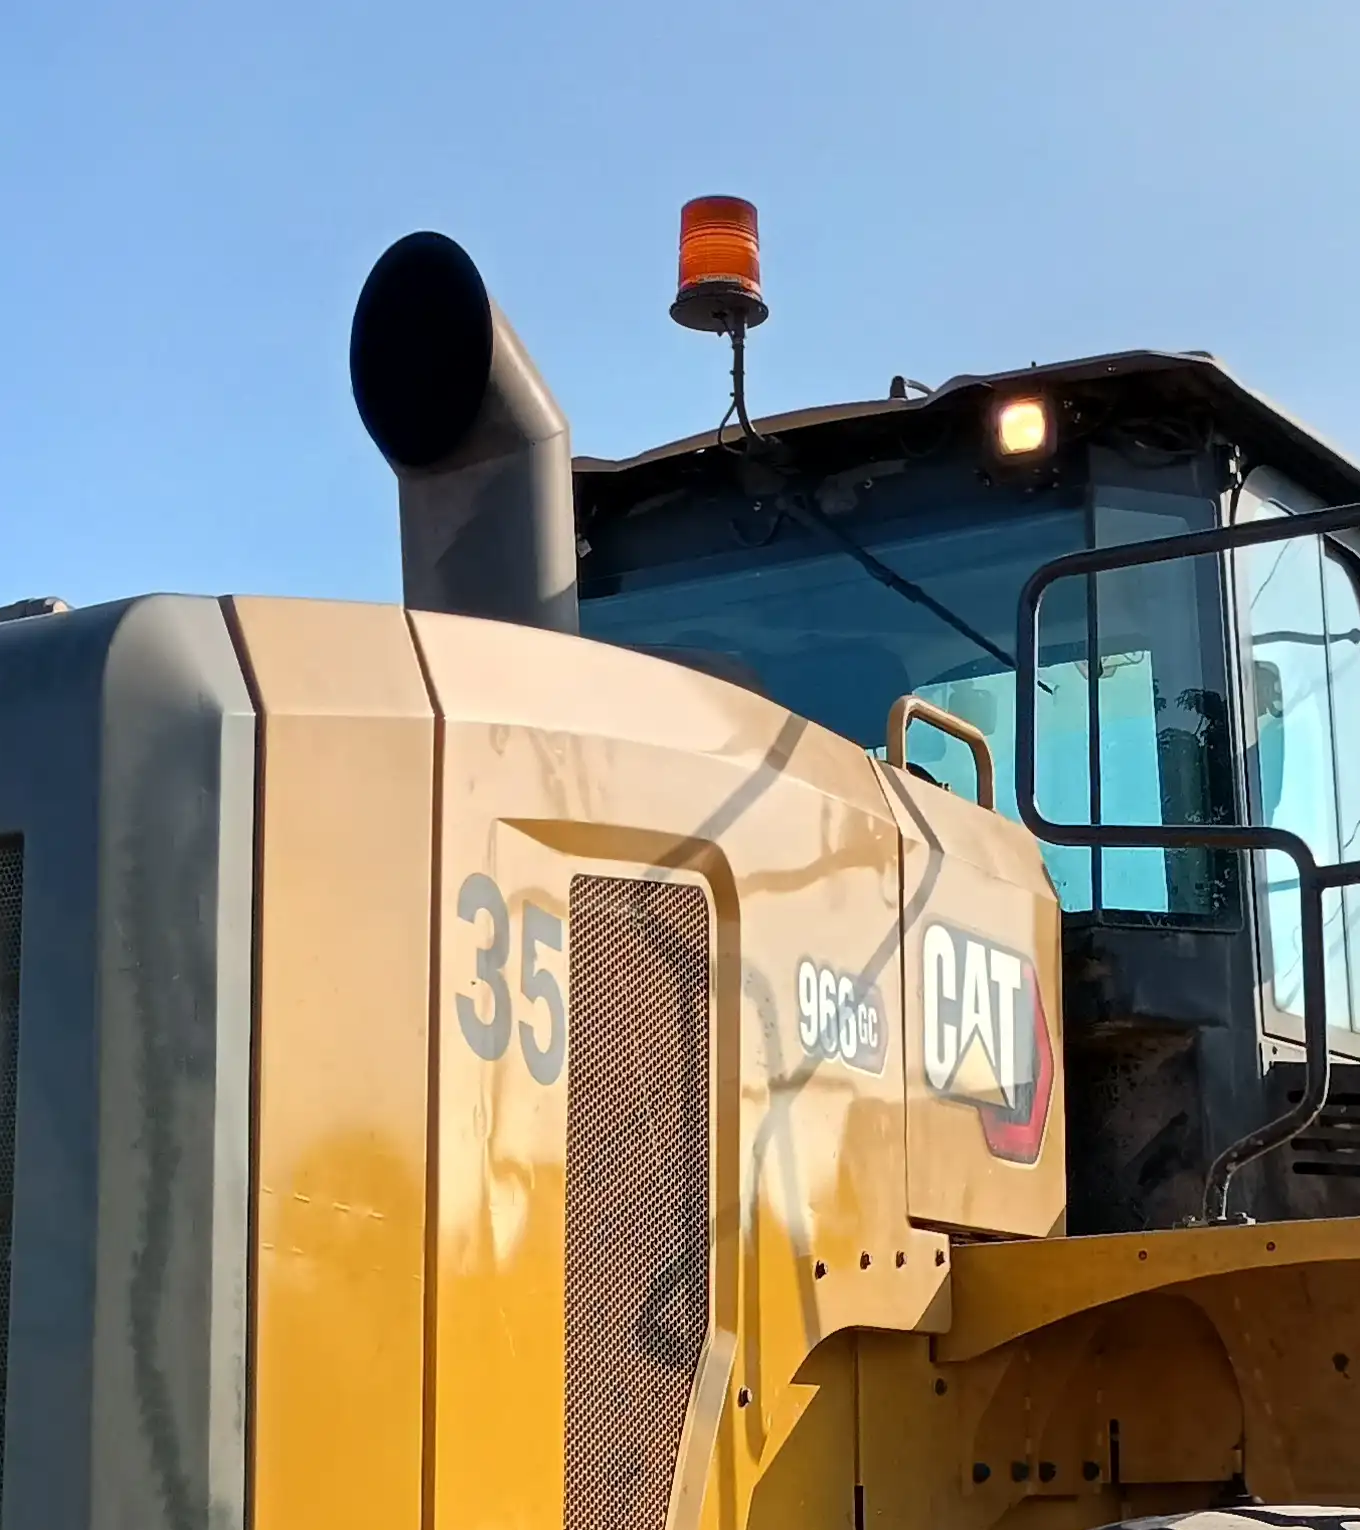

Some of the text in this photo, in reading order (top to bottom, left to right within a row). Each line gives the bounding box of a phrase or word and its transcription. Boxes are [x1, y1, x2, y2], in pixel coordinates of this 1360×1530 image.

[455, 872, 566, 1086] 35
[799, 961, 878, 1058] 966 GC
[923, 924, 1021, 1110] CAT
